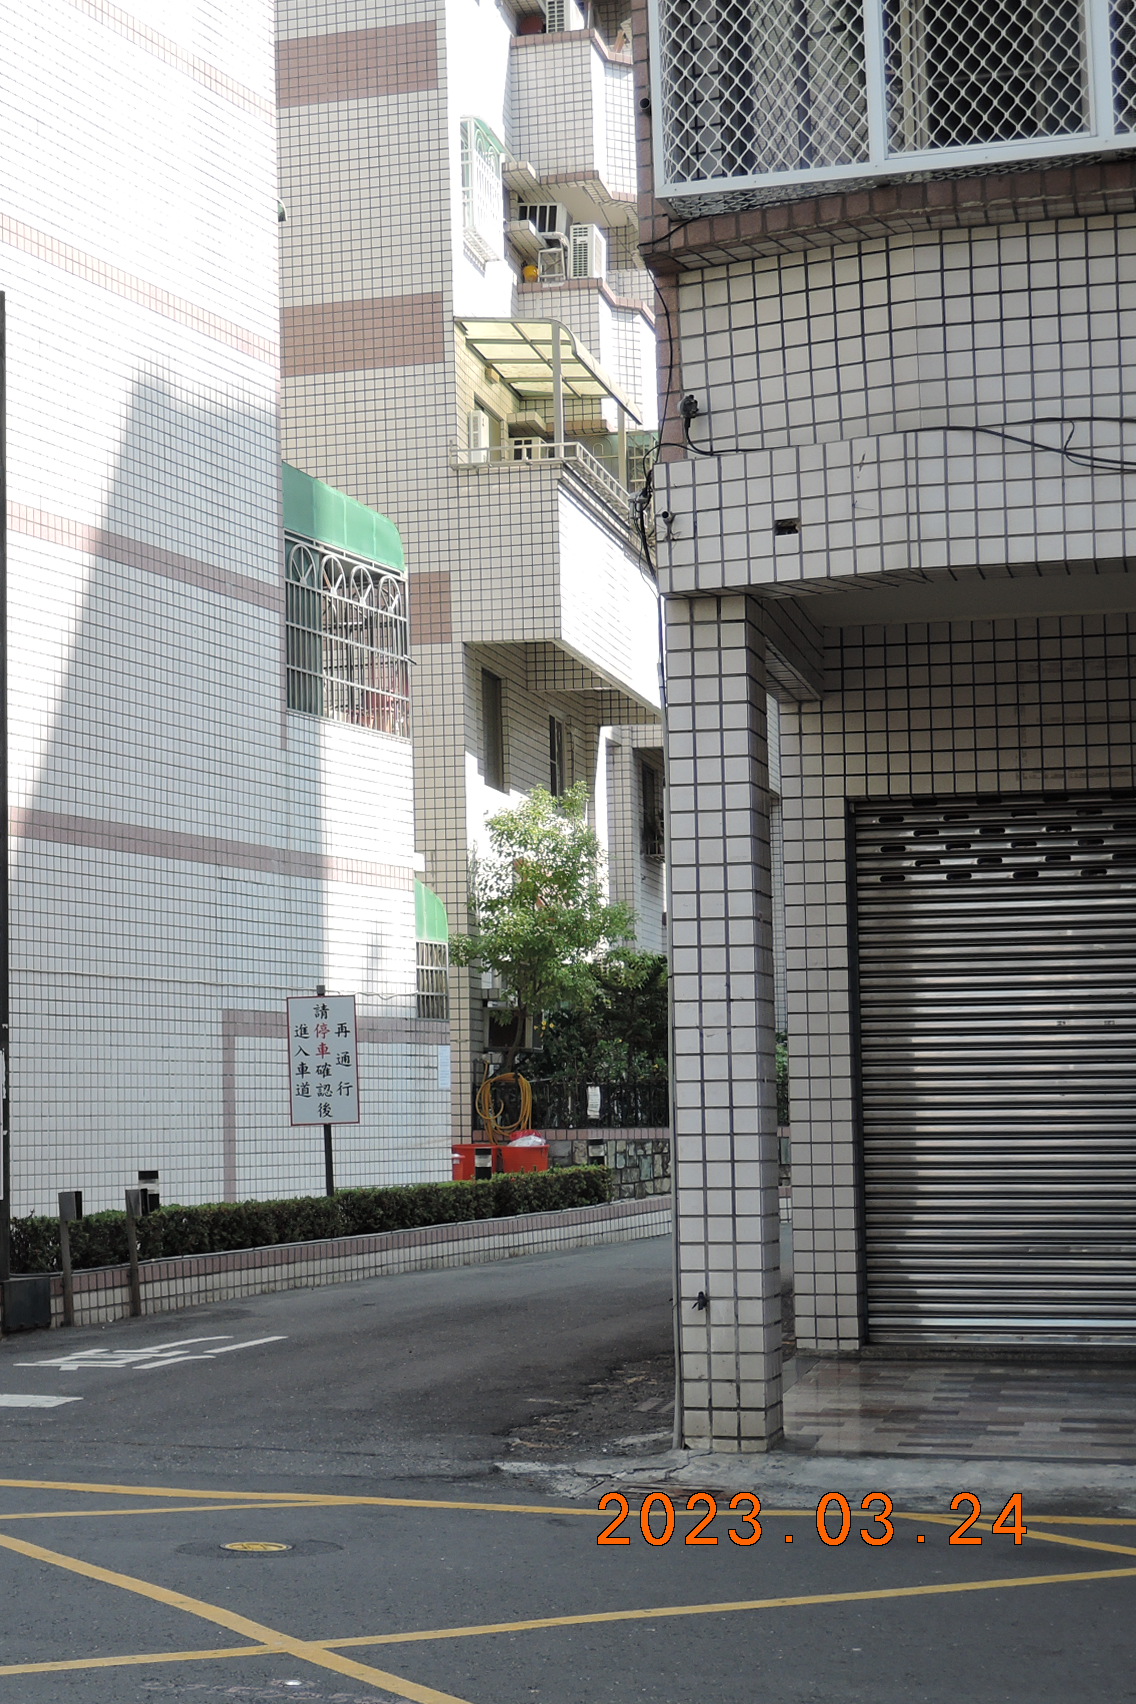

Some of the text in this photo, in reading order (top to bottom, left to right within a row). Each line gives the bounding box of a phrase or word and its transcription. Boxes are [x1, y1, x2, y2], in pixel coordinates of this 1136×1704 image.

[294, 1025, 312, 1098] 進入車道
[313, 1003, 333, 1119] 請停車確認後
[334, 1022, 353, 1097] 再通行
